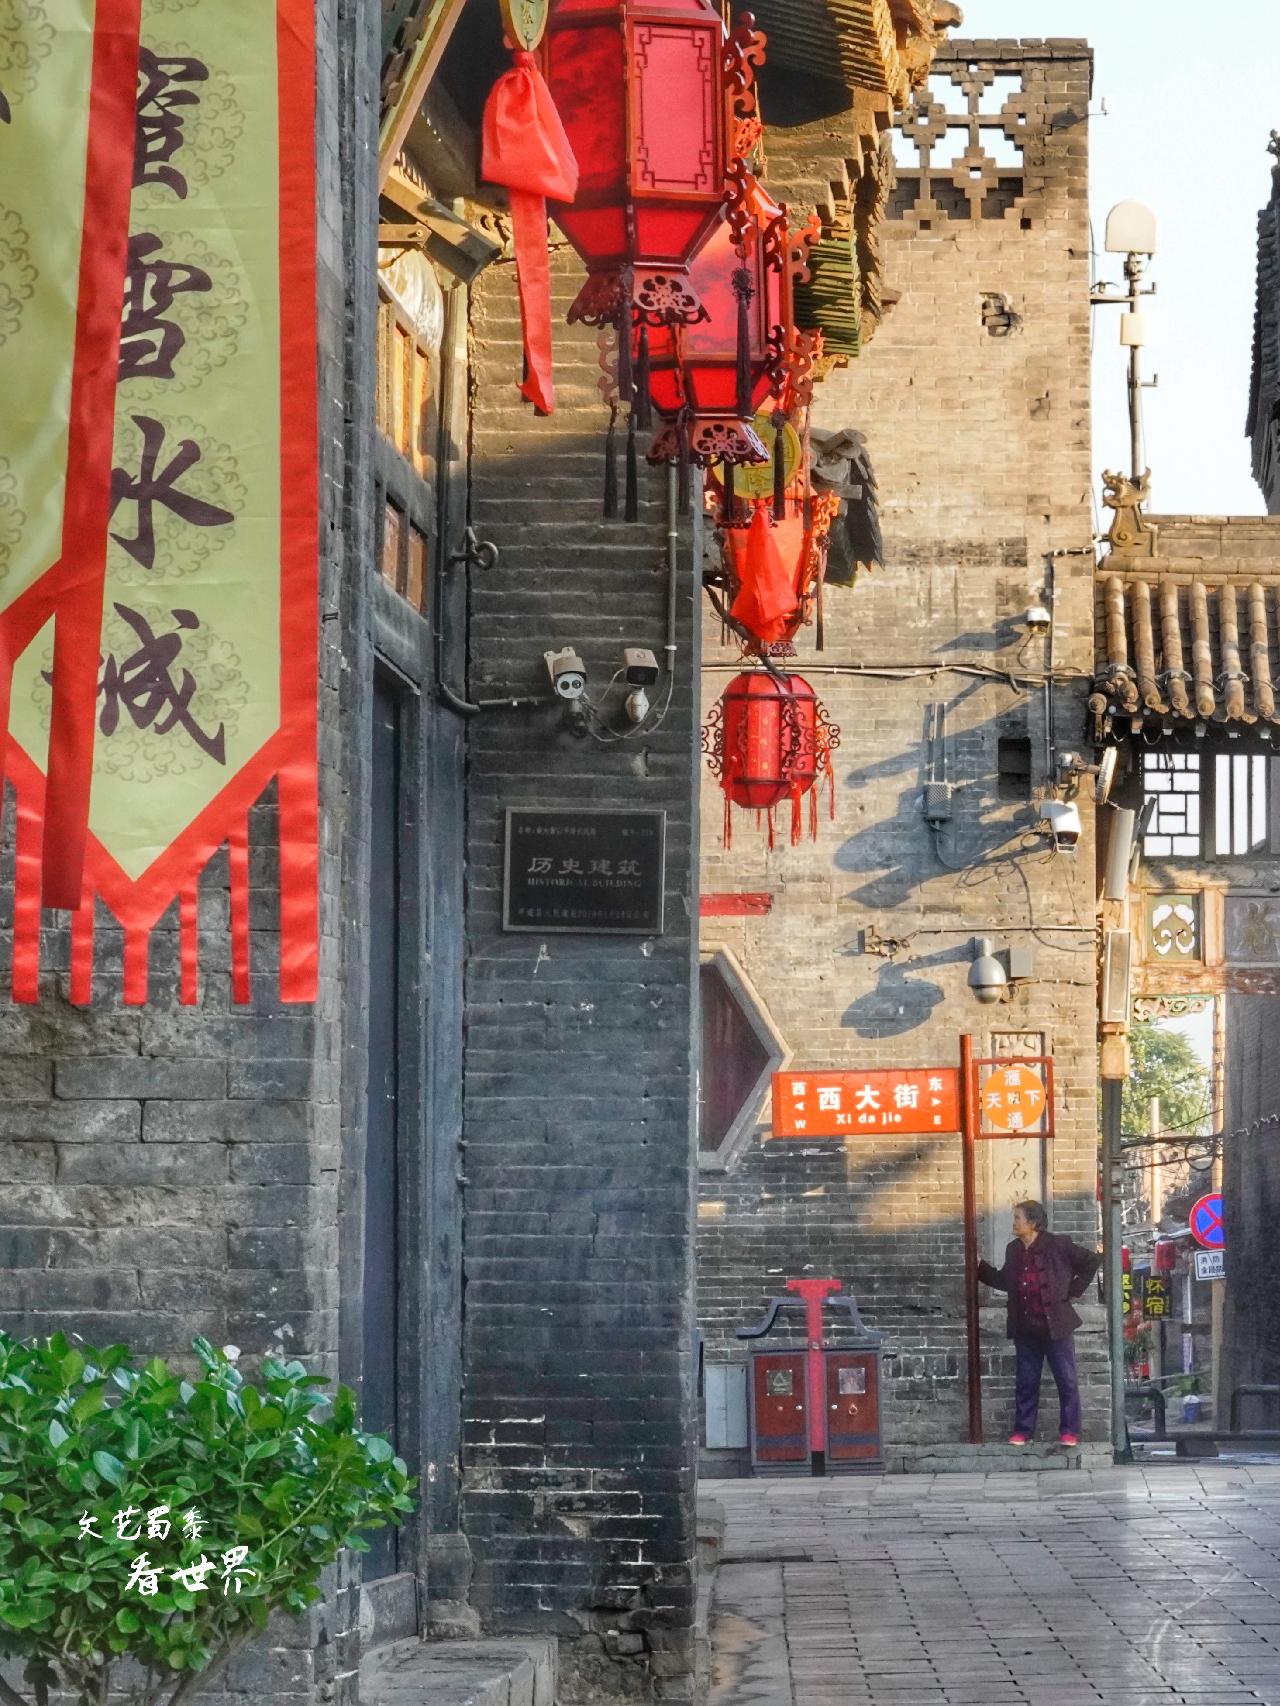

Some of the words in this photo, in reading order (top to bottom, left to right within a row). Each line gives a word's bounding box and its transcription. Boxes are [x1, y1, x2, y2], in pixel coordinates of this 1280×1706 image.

[527, 857, 642, 876] 历史建筑
[527, 878, 589, 887] HISTORICAL
[592, 879, 642, 889] BUILDING
[791, 1081, 807, 1096] 西
[928, 1076, 943, 1092] 东
[816, 1083, 919, 1111] 西大街
[986, 1092, 1002, 1109] 天
[1024, 1089, 1041, 1107] 下
[794, 1119, 807, 1129] W
[835, 1113, 852, 1125] Xi
[857, 1113, 876, 1124] da
[881, 1112, 902, 1125] jie
[933, 1114, 942, 1125] E
[1007, 1111, 1025, 1129] 通
